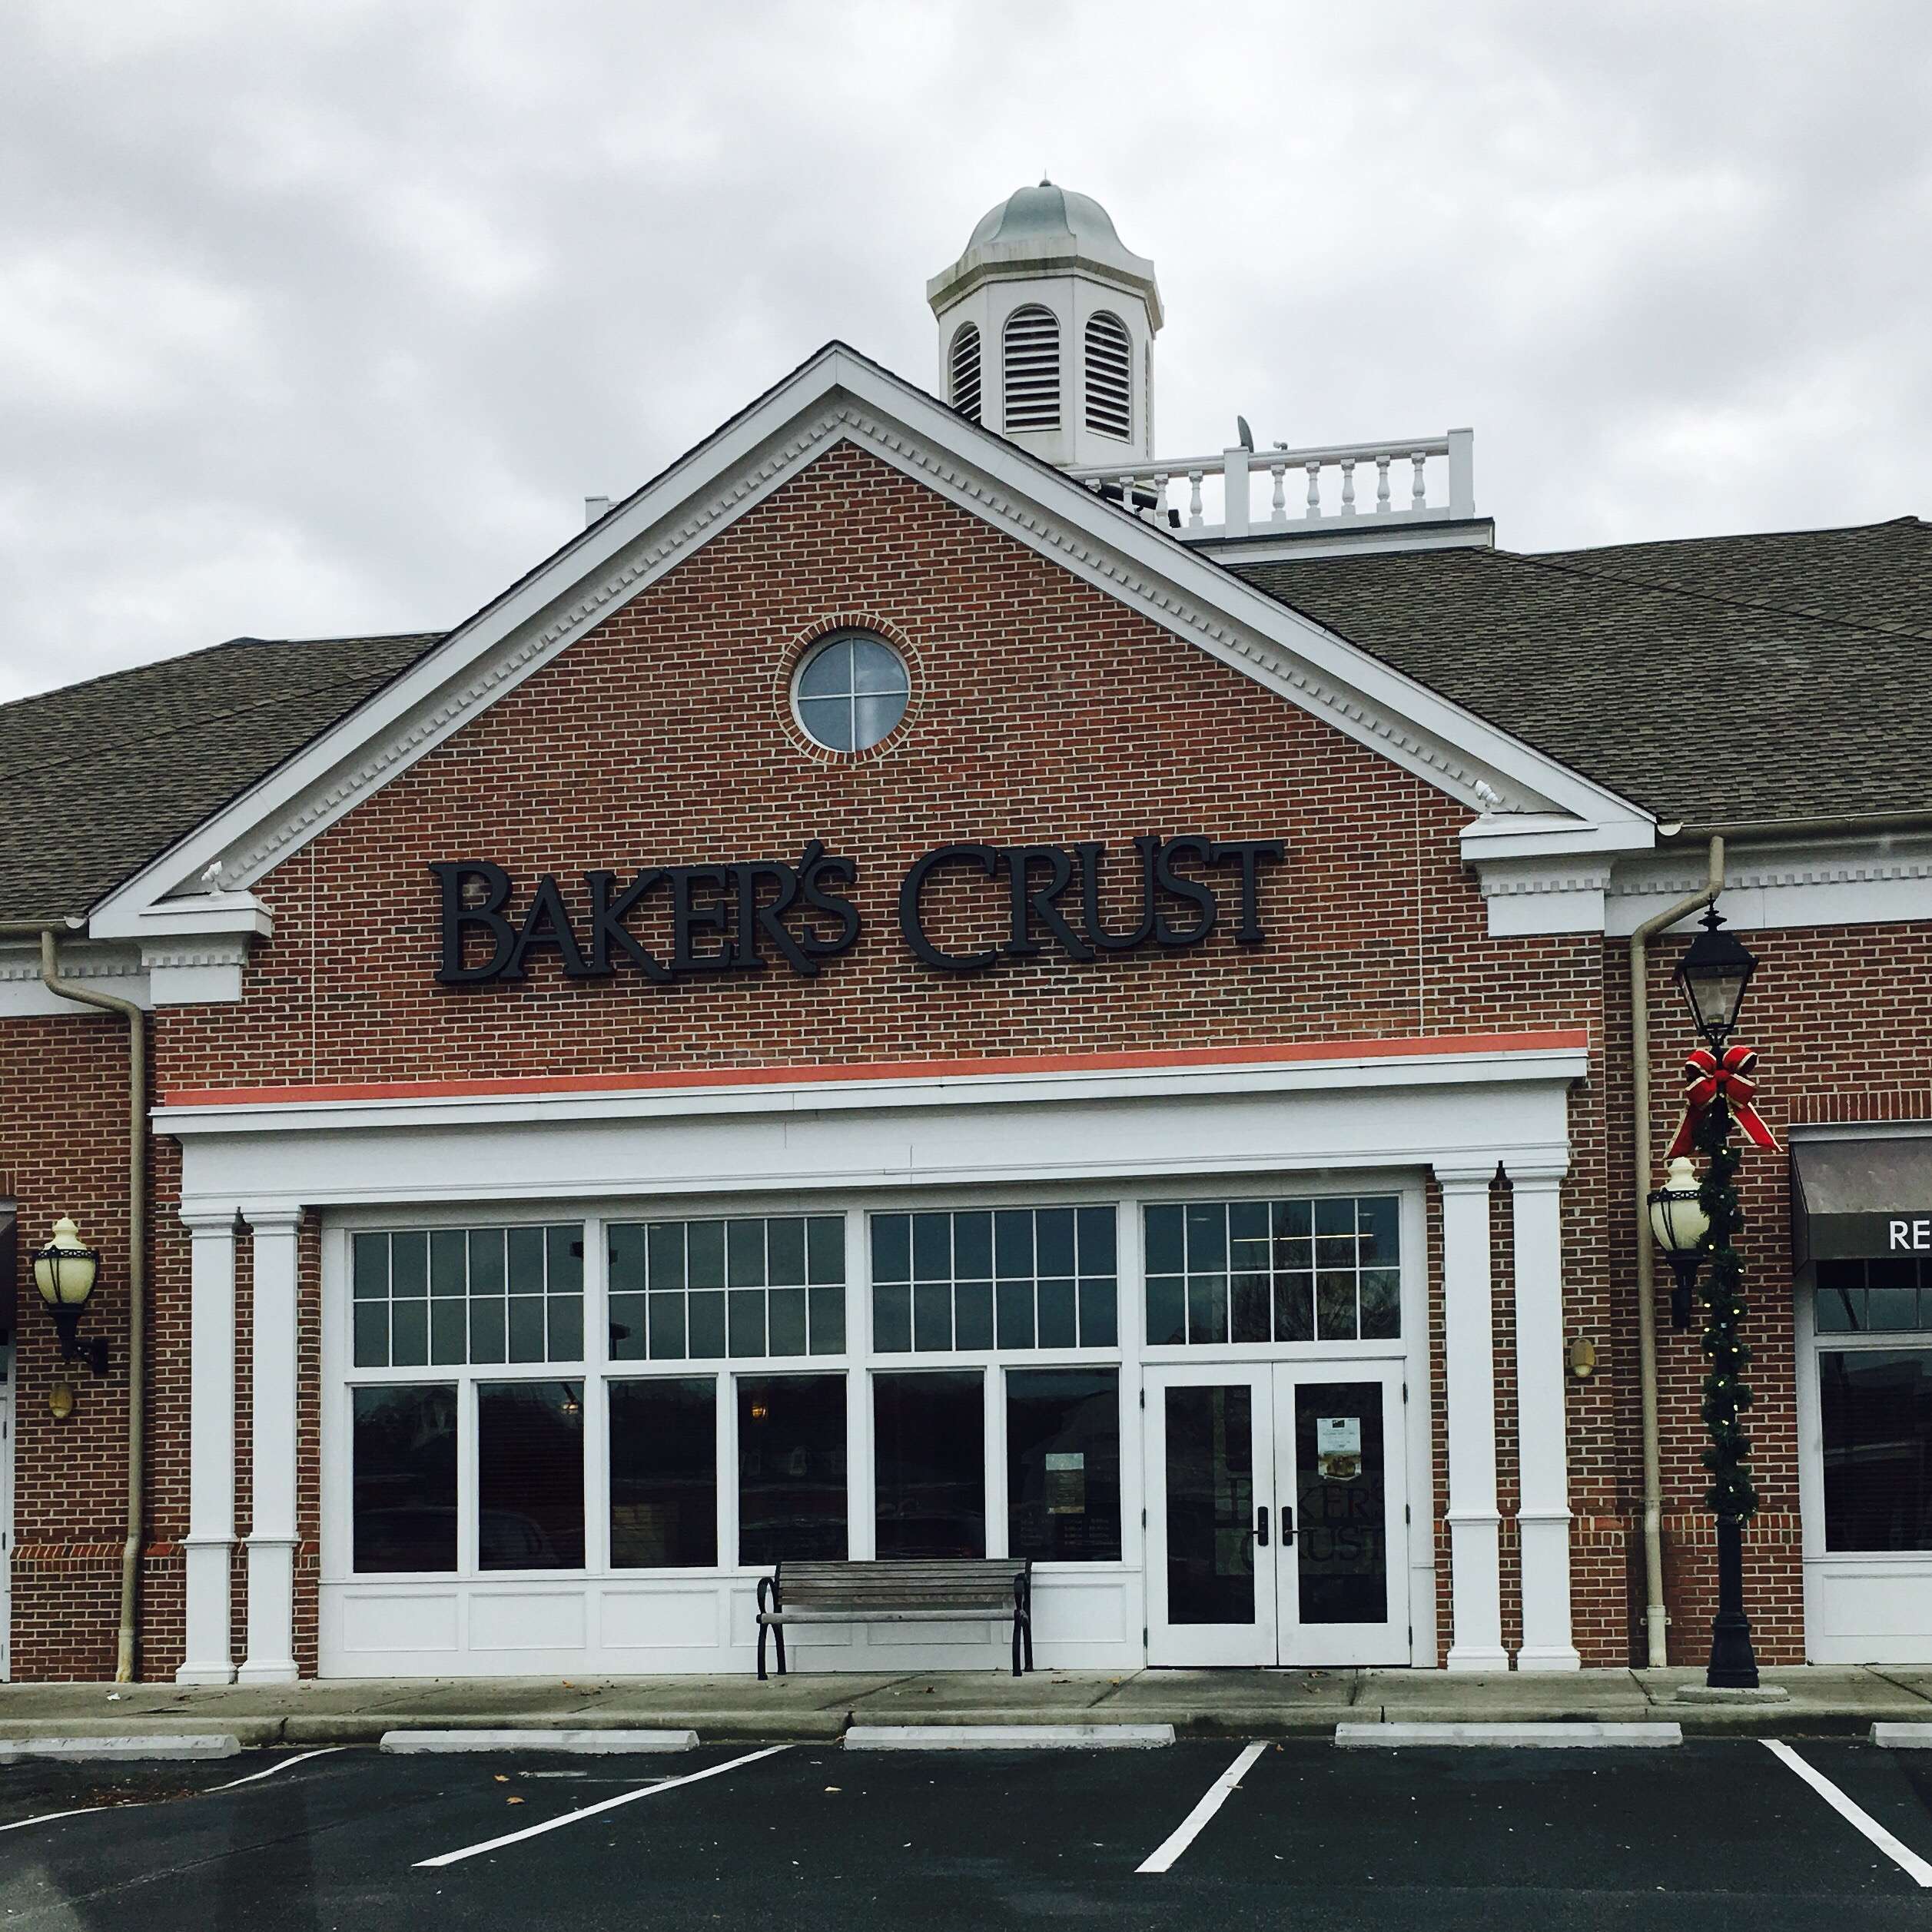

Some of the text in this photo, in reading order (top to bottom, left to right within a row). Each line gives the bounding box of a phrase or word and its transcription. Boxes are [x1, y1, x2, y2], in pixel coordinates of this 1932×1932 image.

[429, 835, 1285, 983] BAKER'S CRUST
[1889, 1220, 1930, 1250] RE
